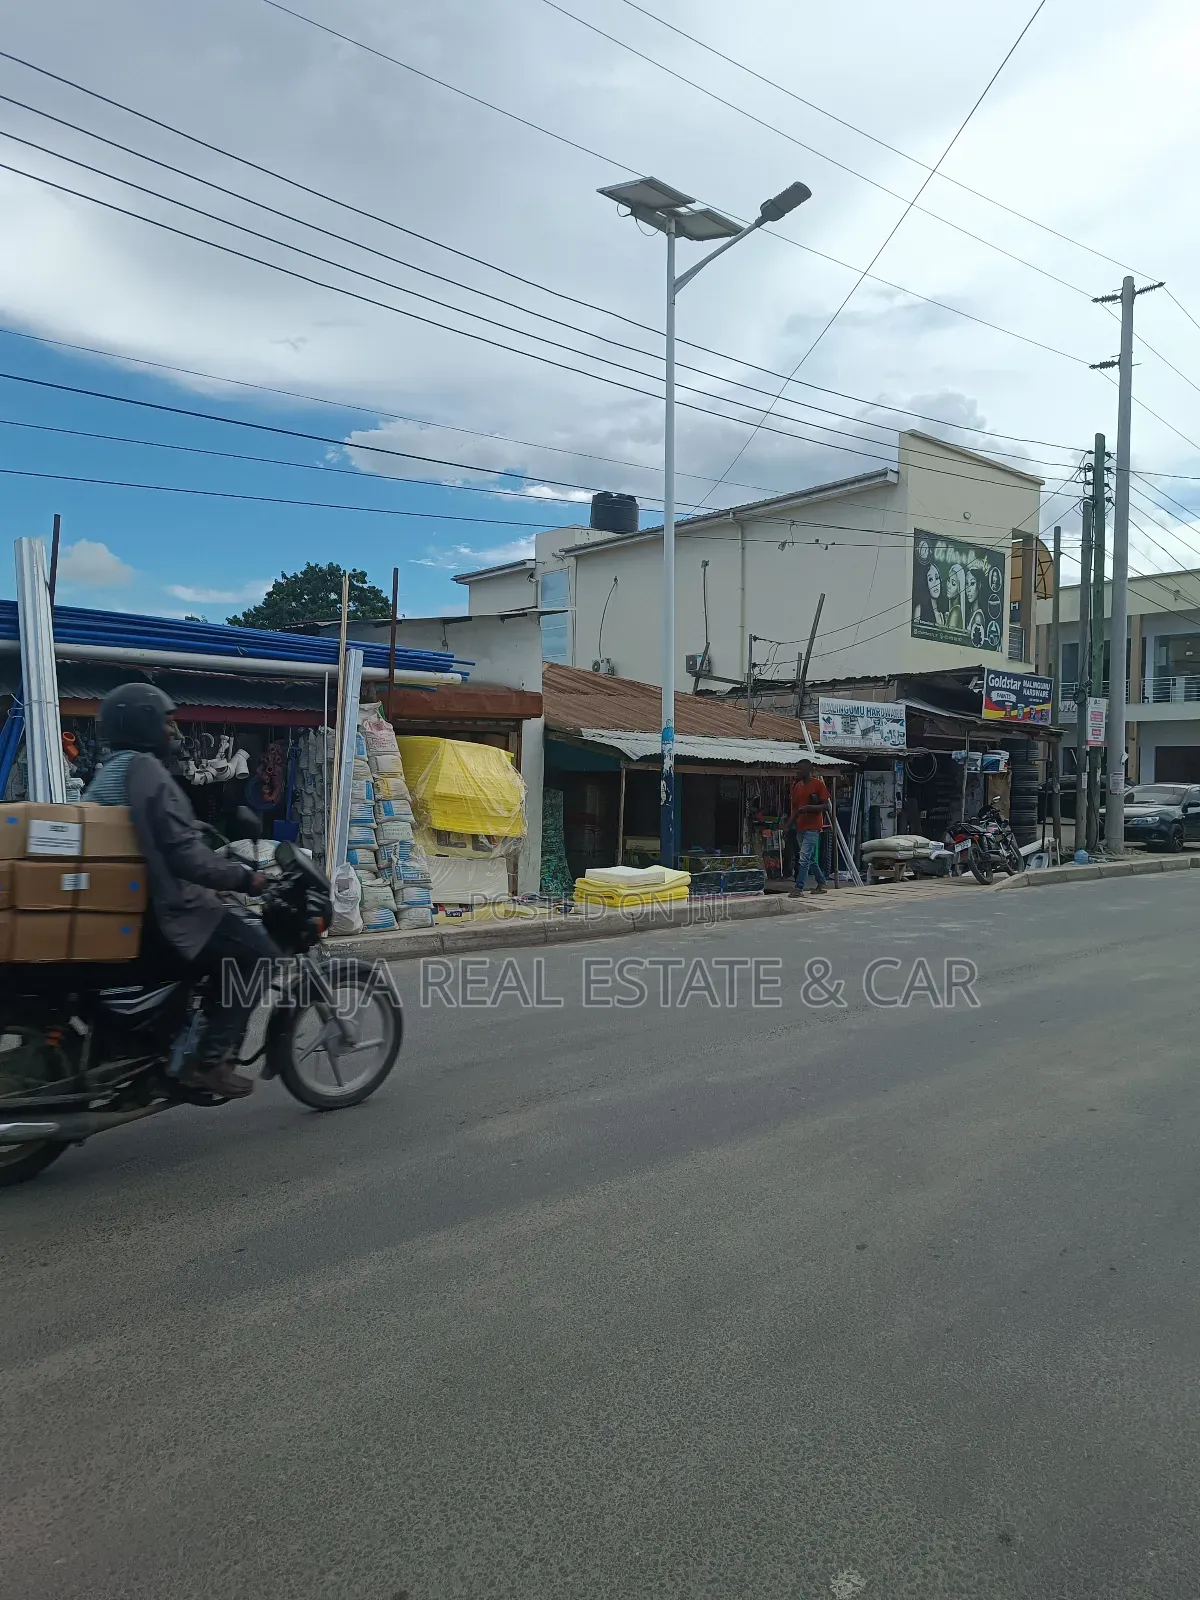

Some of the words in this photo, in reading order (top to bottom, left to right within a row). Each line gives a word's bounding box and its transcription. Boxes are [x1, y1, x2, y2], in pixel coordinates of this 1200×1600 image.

[988, 673, 1021, 690] Goldstar
[1022, 687, 1049, 698] HARDWARE
[866, 706, 905, 719] HARDWARE
